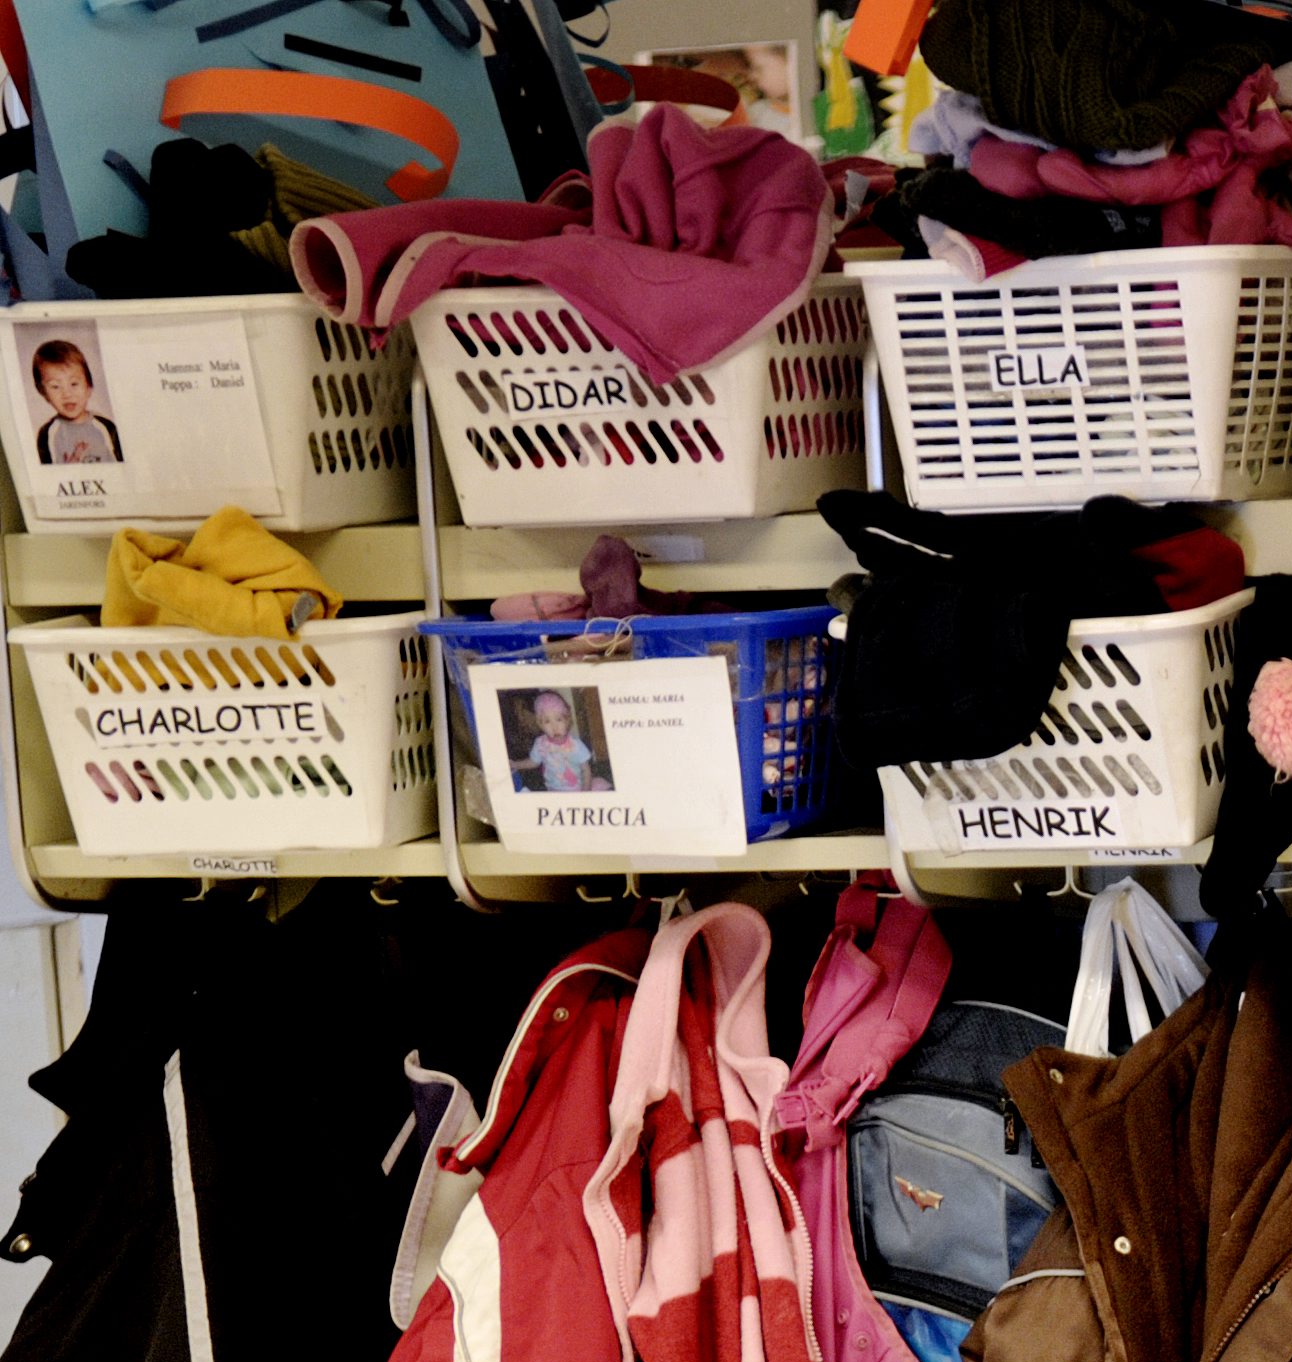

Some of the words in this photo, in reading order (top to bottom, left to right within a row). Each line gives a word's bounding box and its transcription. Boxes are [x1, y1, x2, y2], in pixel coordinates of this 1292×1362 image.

[209, 359, 241, 371] Maria
[995, 353, 1083, 386] ELLA
[210, 376, 245, 388] Daniel
[510, 376, 627, 412] DIDAR
[56, 479, 108, 497] ALEX
[608, 695, 649, 705] MAMMA:
[652, 693, 685, 704] MARIA
[96, 702, 316, 737] CHARLOTTE
[612, 719, 644, 729] PAPPA:
[647, 718, 685, 728] DANIEL
[537, 807, 648, 827] PATRICIA
[958, 805, 1117, 839] HENRIK
[193, 857, 278, 873] CHARLOTTE
